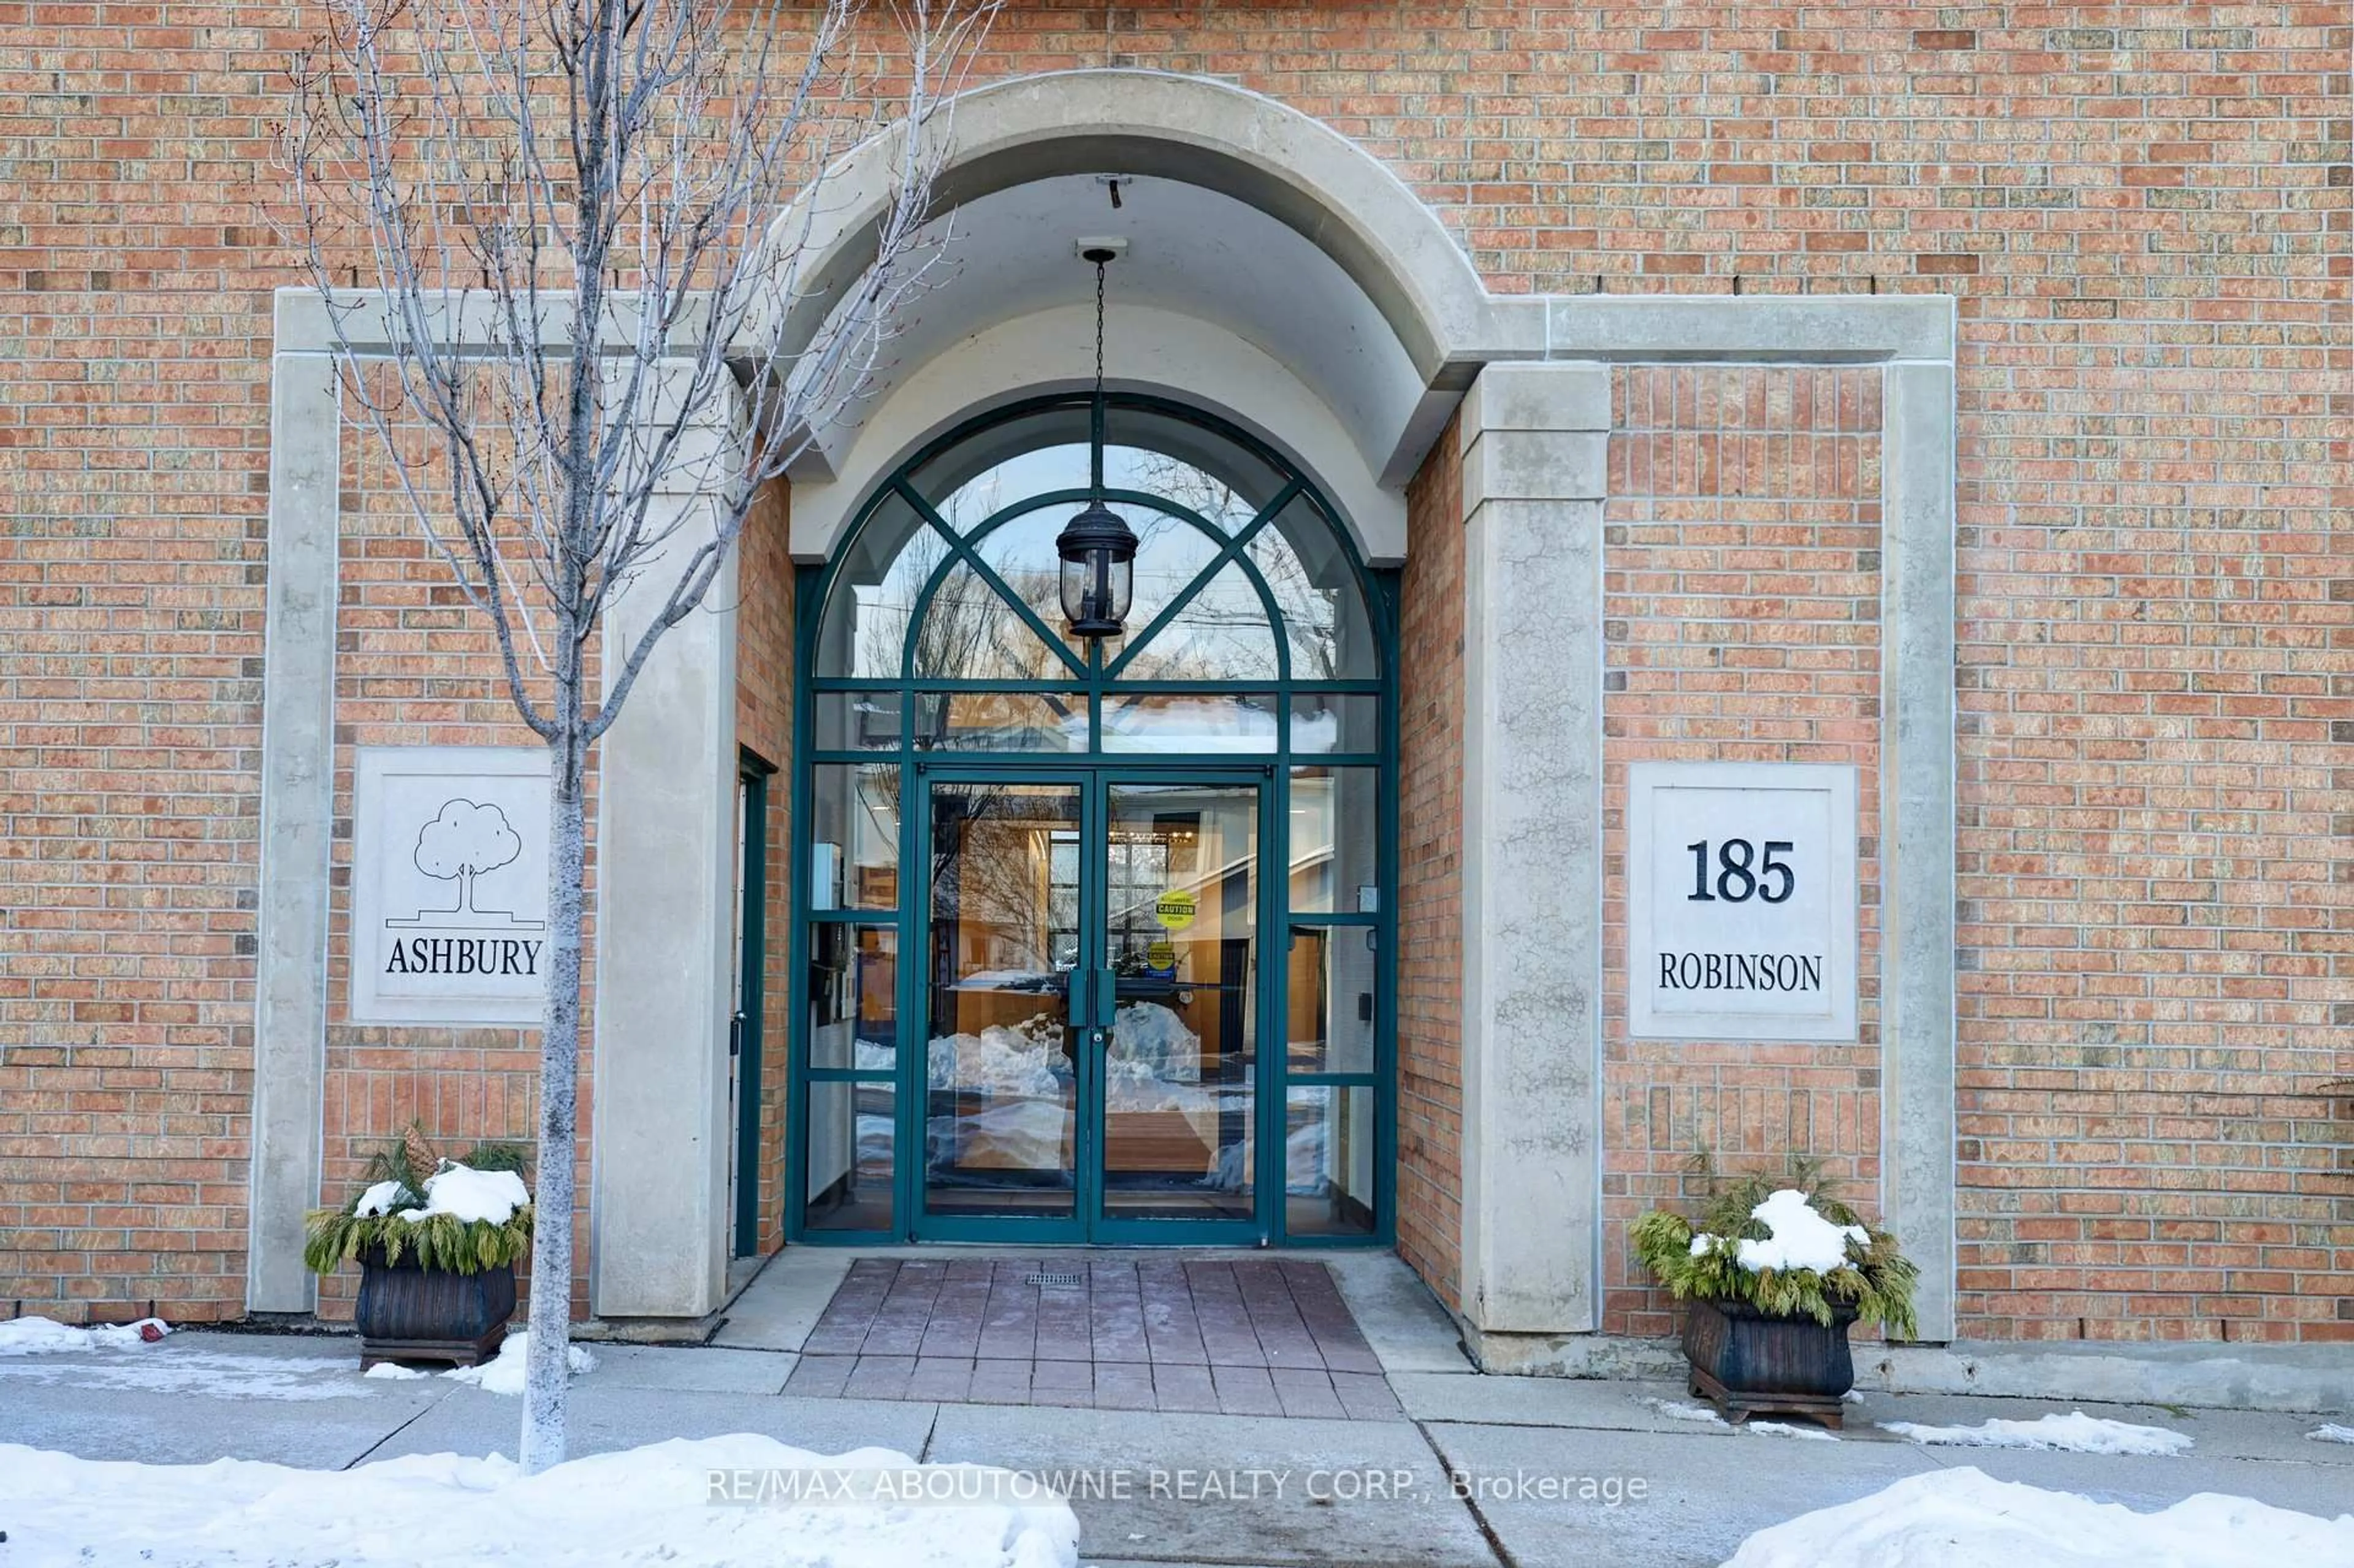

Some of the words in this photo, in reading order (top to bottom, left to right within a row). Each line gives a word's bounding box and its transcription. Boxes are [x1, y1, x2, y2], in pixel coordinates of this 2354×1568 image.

[1687, 839, 1794, 903] 185
[1158, 905, 1193, 913] CAUTION
[386, 937, 543, 975] ASHBURY
[1659, 953, 1823, 991] ROBINSON
